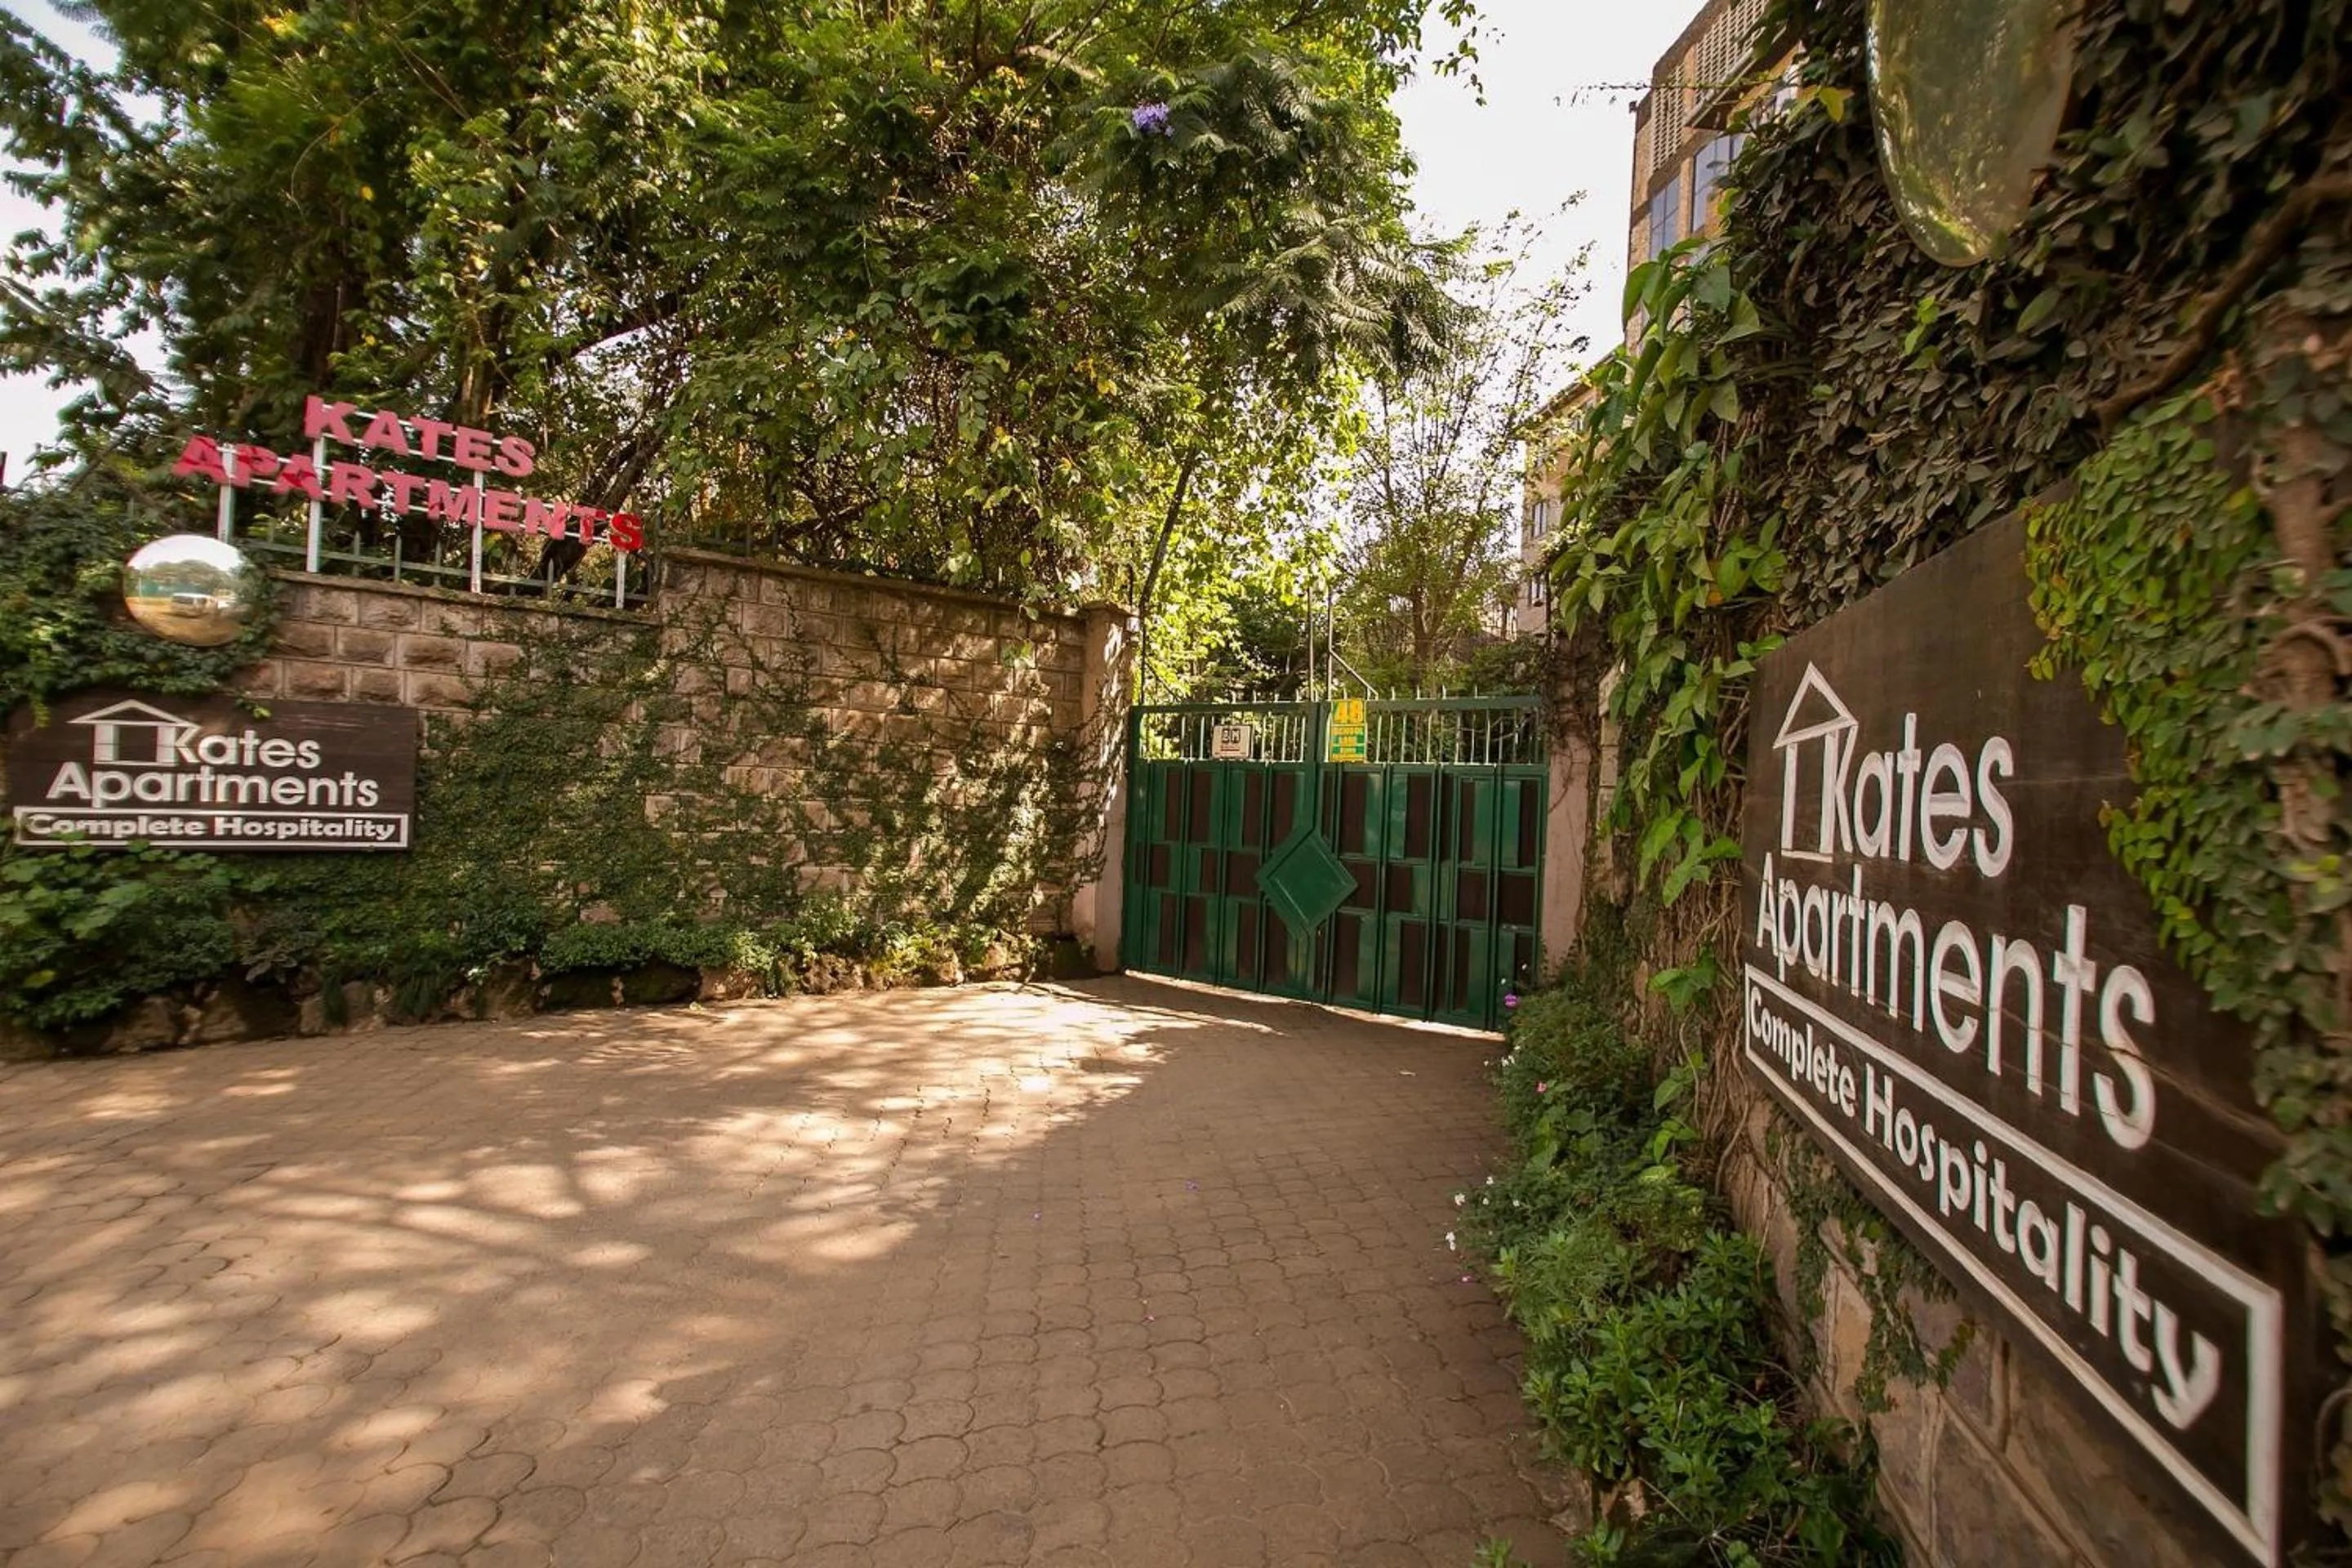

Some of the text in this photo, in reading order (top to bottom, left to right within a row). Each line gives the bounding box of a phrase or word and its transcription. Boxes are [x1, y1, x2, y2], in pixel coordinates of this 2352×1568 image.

[304, 394, 535, 477] KATES
[171, 435, 644, 552] APARTMENTS
[46, 761, 380, 808] Apartments
[156, 724, 321, 769] Kates
[1820, 713, 2013, 877] Kates
[25, 813, 395, 840] Complete Hospitality
[1756, 852, 2154, 1149] Apartments
[1748, 991, 2220, 1430] Complete Hospitality
